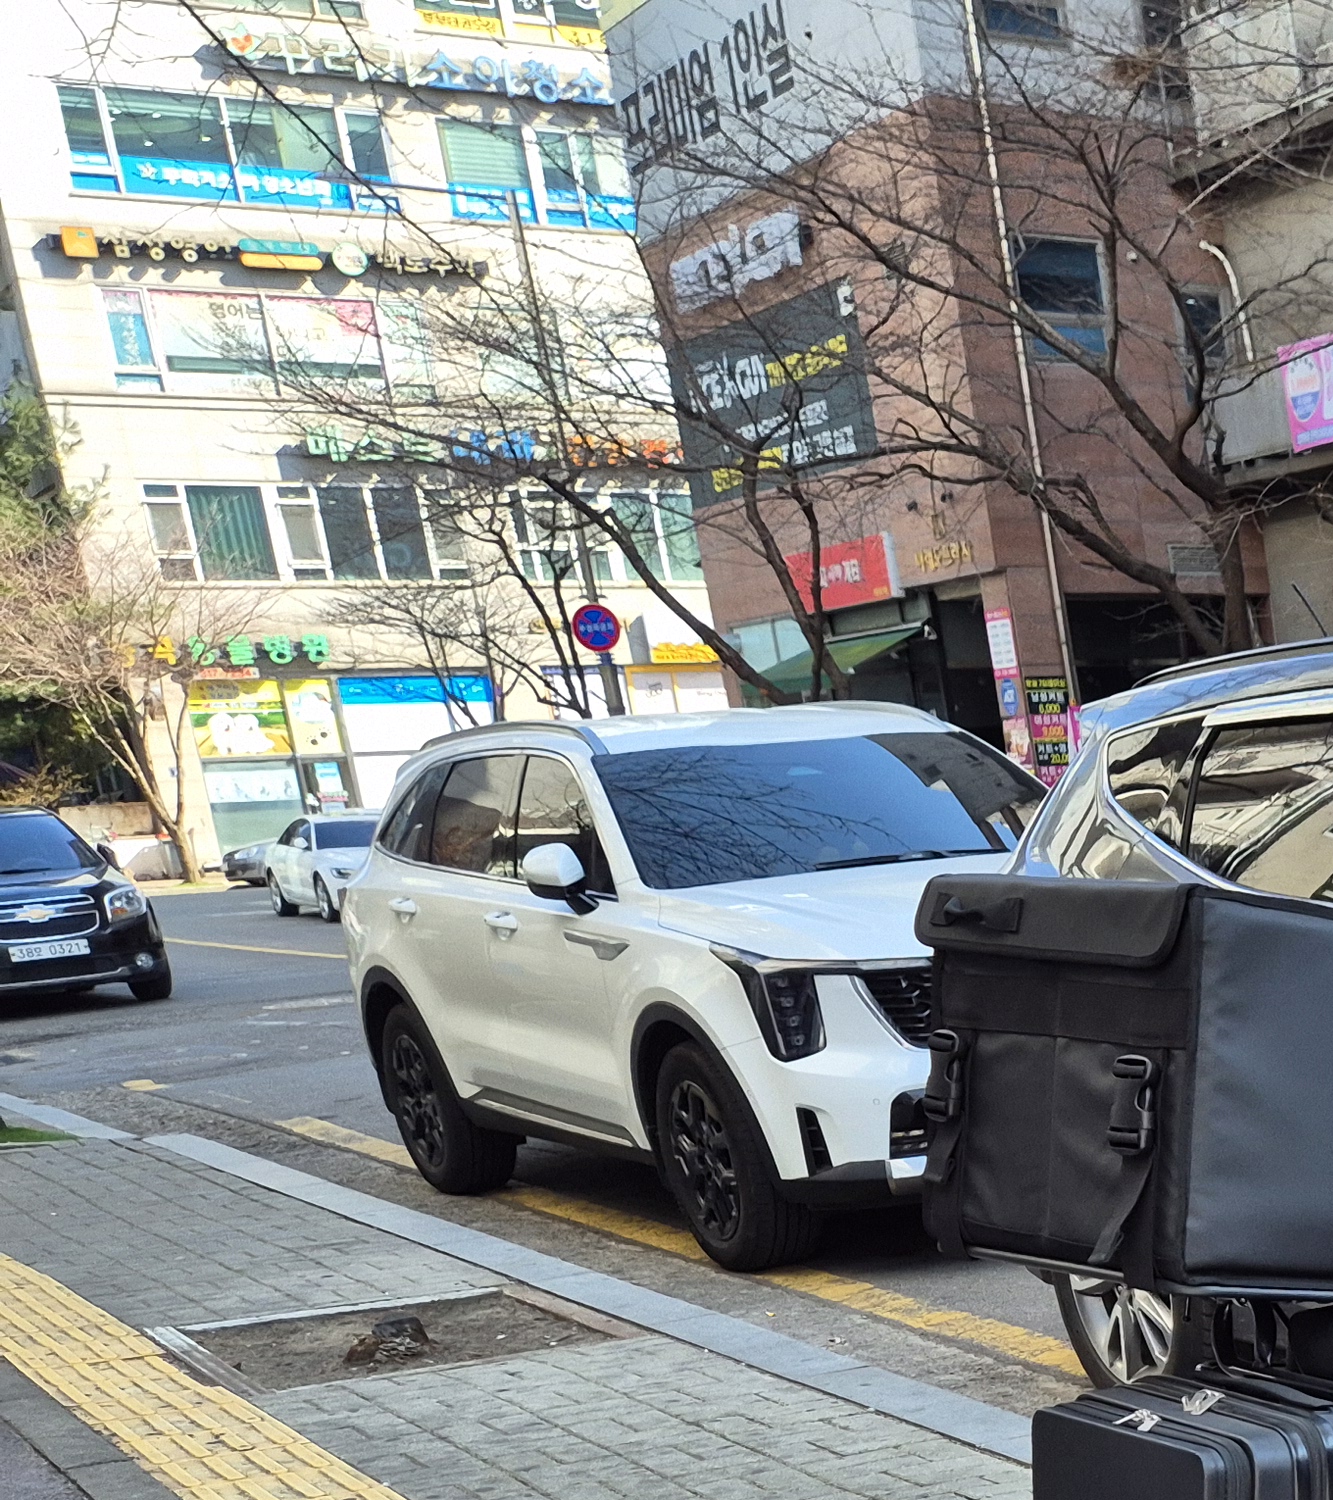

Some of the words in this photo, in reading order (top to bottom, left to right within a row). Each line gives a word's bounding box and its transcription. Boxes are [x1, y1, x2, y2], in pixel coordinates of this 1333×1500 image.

[620, 42, 720, 177] 프리미엄
[721, 0, 794, 113] 1인실
[50, 942, 82, 956] 0321
